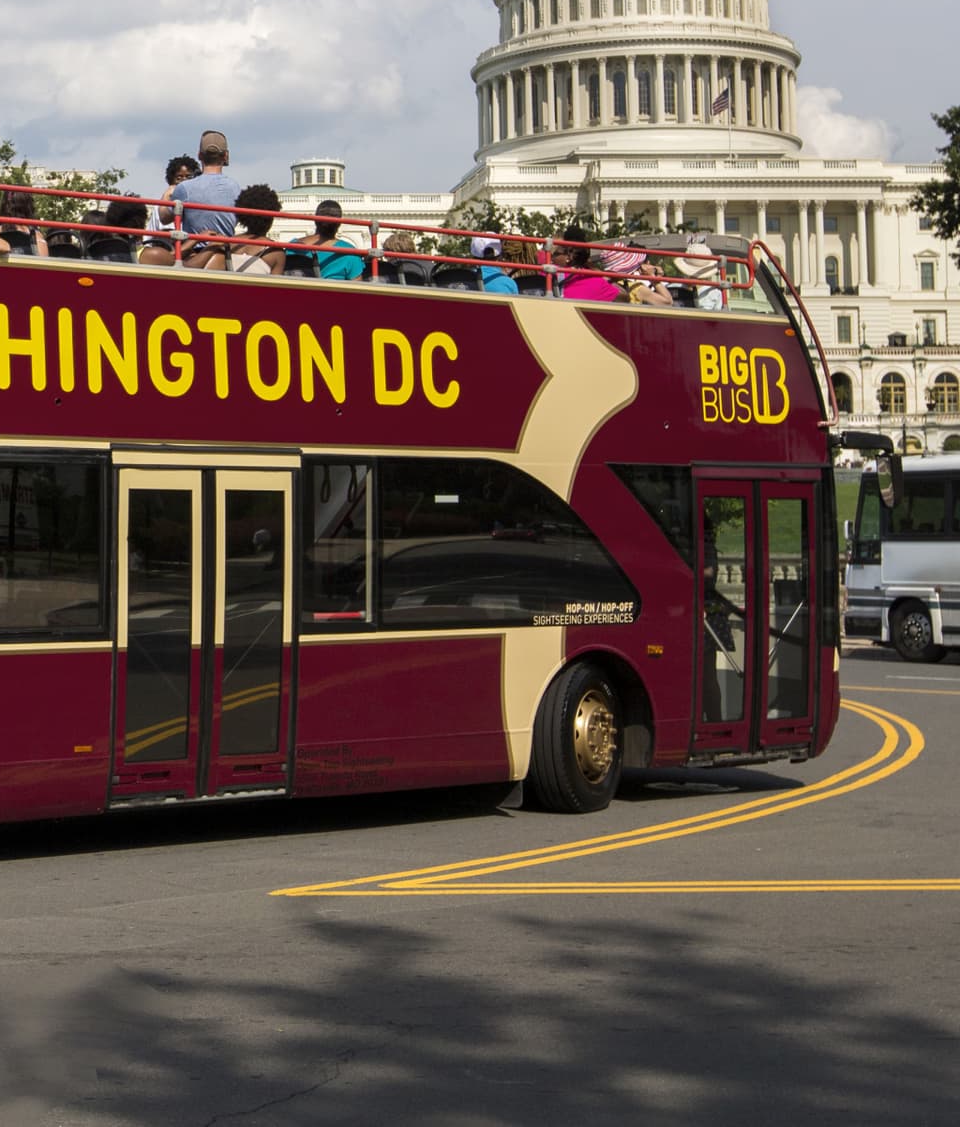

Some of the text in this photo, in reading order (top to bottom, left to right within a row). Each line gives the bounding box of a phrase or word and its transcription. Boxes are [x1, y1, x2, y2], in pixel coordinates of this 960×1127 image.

[372, 328, 460, 408] DC
[699, 344, 749, 386] BIG
[702, 386, 752, 424] BUS
[533, 613, 634, 626] SIGHTSEEING EXPERIENCES
[565, 603, 595, 613] HOP-ON
[601, 601, 634, 612] HOP-OFF
